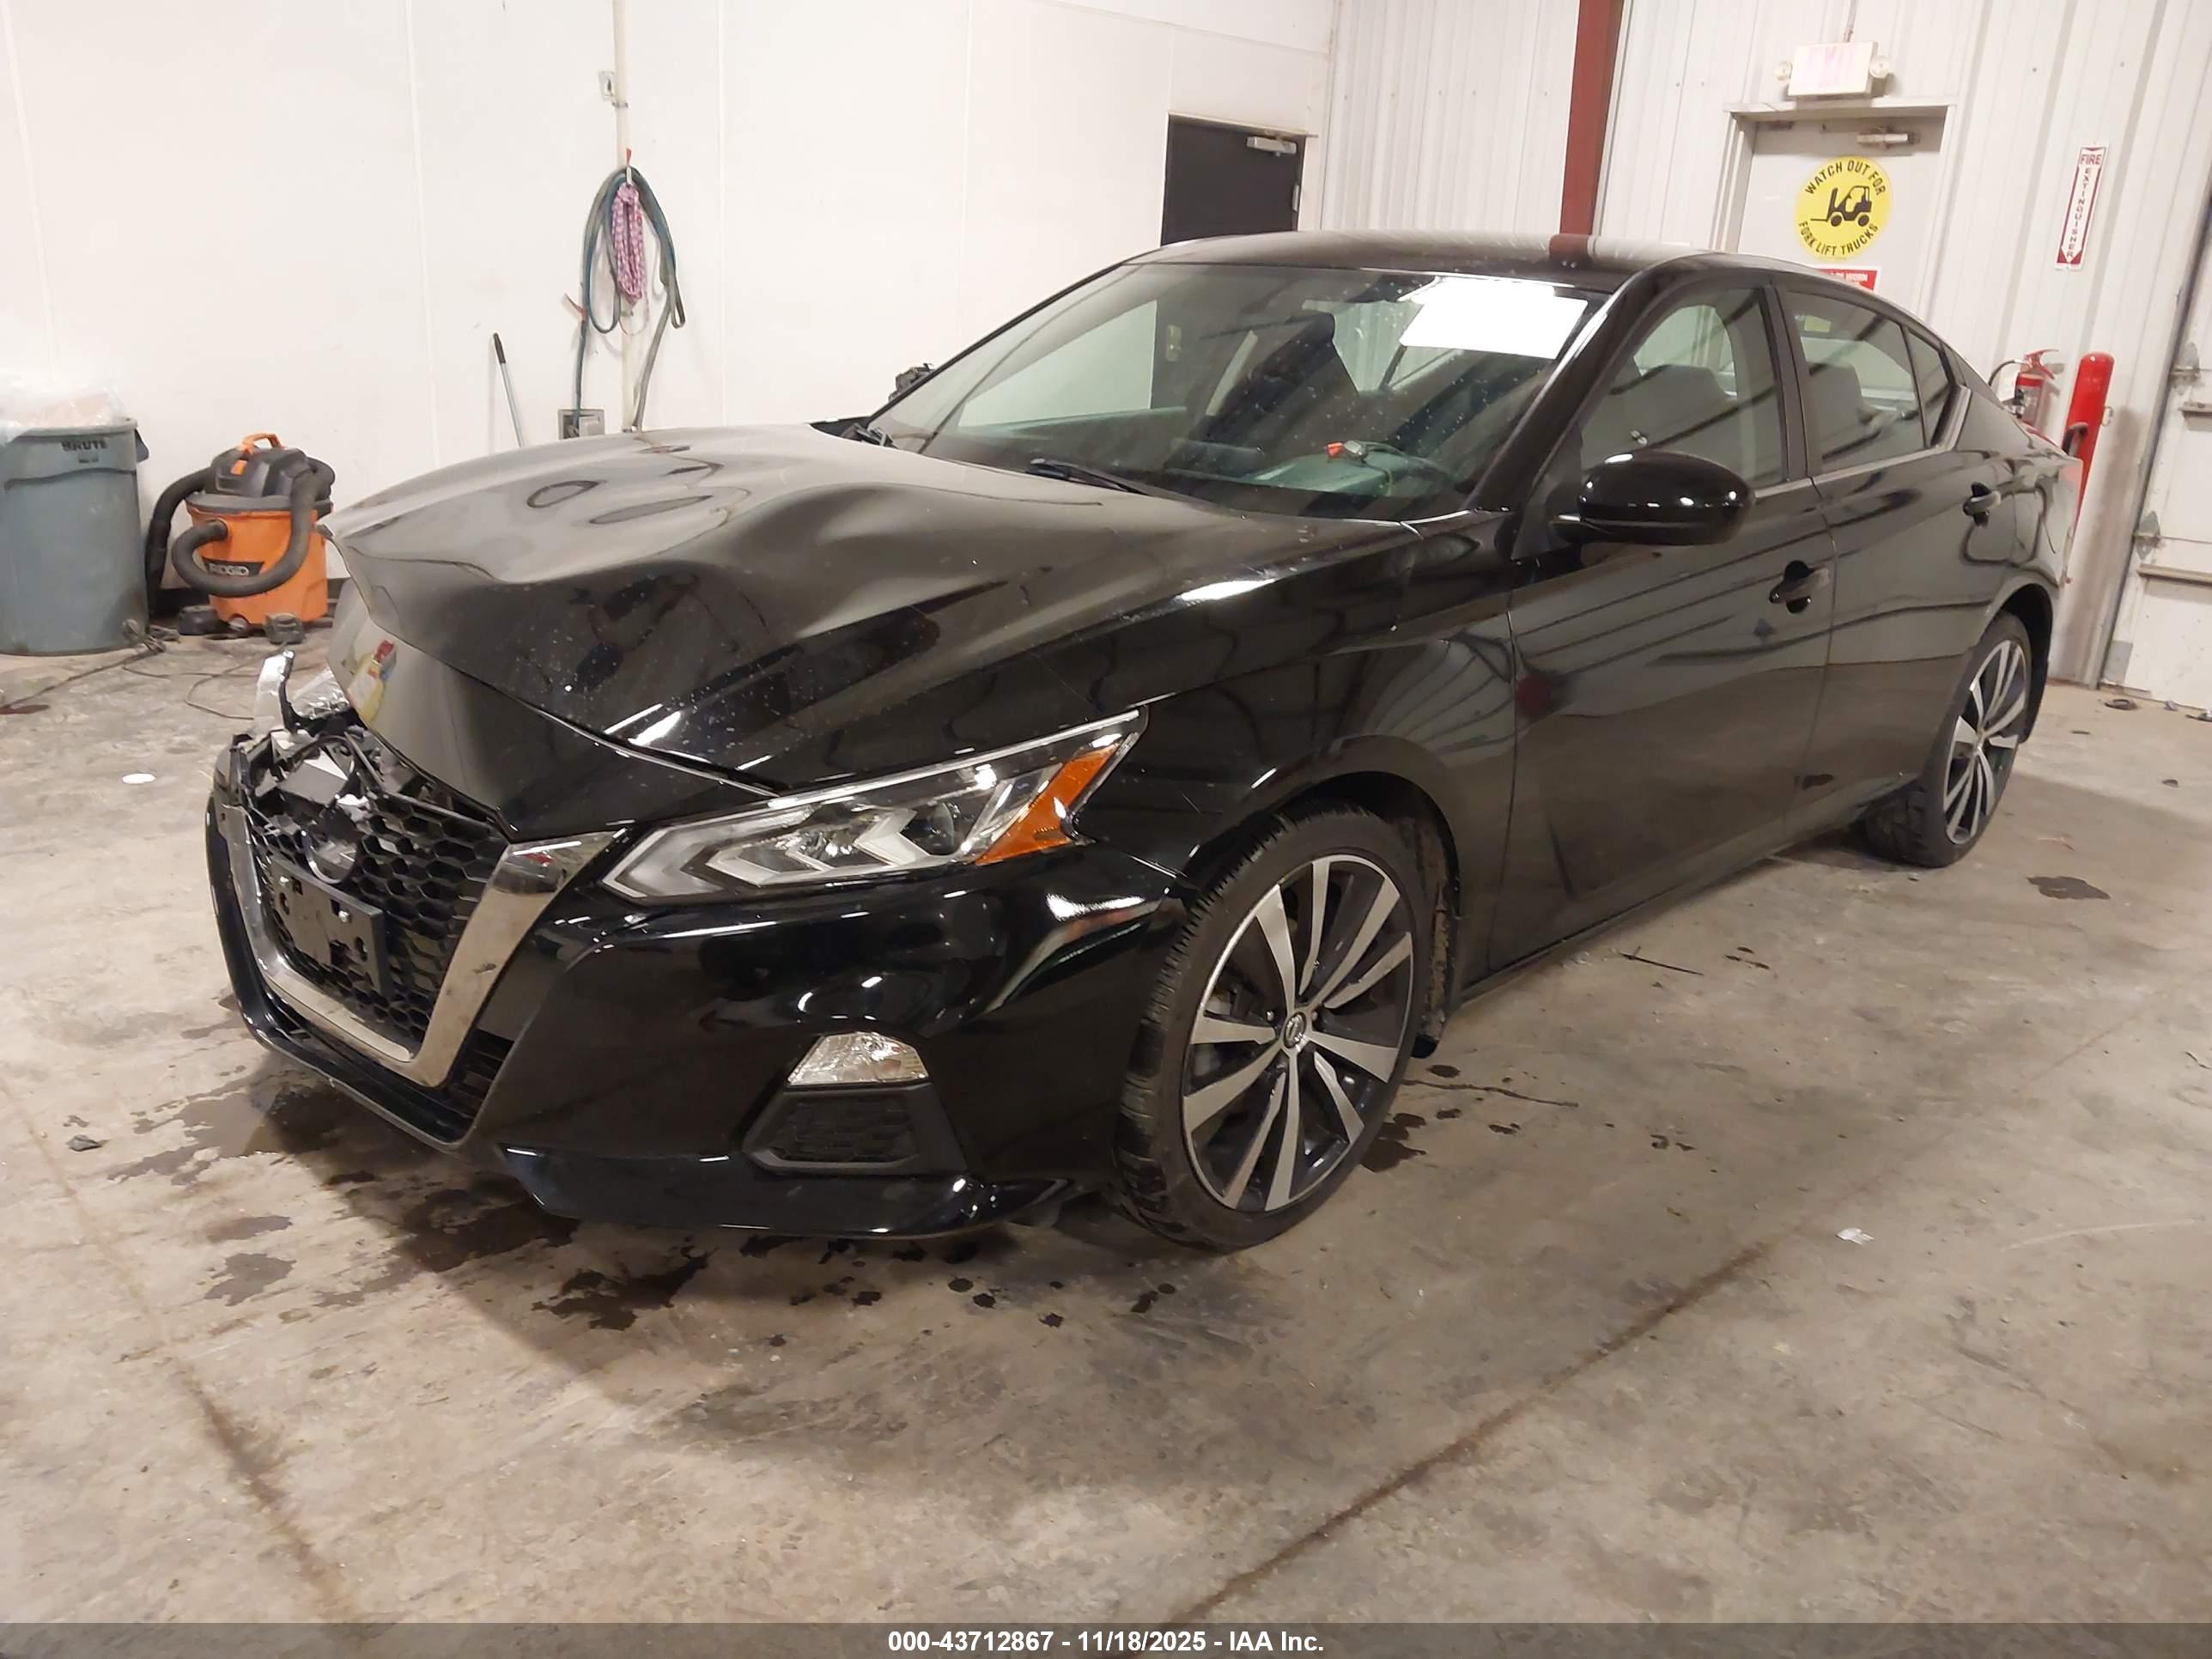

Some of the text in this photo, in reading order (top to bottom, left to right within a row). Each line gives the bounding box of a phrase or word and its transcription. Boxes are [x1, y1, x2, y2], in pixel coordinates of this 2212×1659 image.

[2081, 155, 2102, 165] FIRE
[1805, 160, 1887, 196] WATCH OUT FOR
[2067, 167, 2090, 258] EXTINGUISHER
[1798, 221, 1879, 256] FORK LIFT TRUCKS
